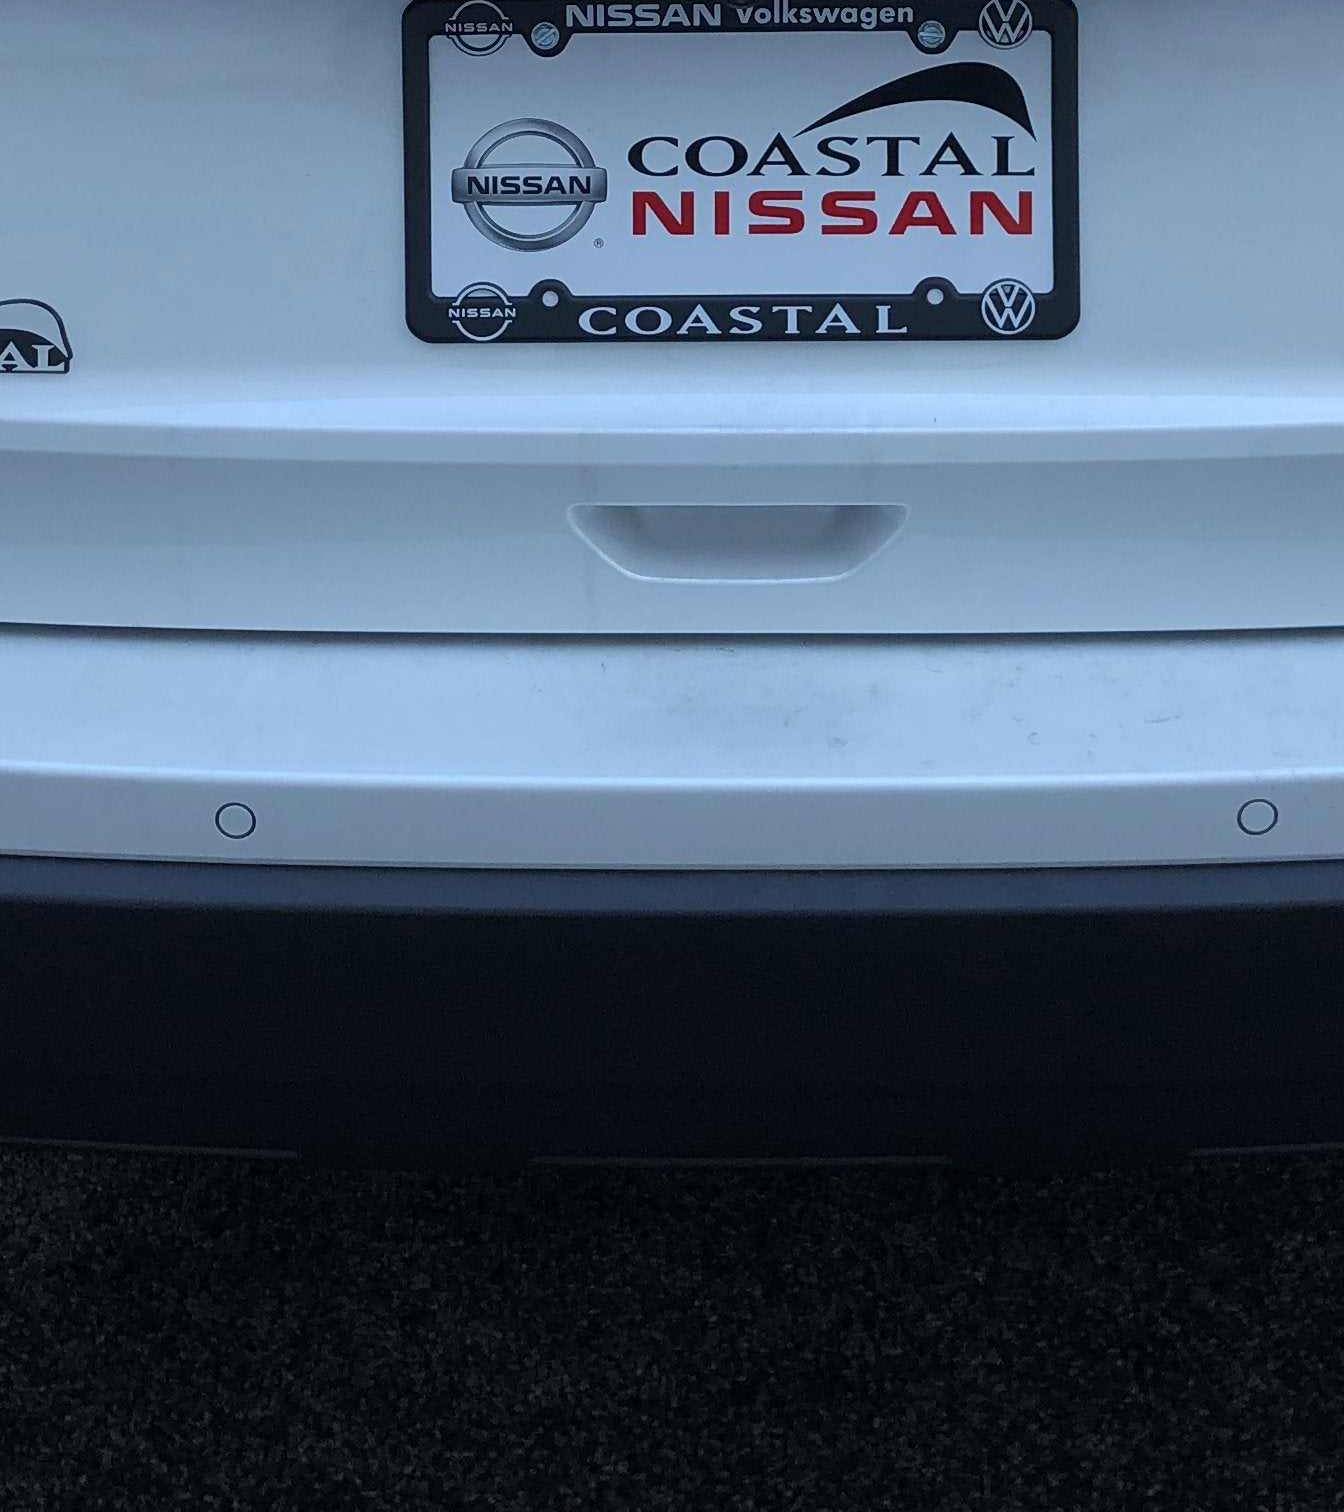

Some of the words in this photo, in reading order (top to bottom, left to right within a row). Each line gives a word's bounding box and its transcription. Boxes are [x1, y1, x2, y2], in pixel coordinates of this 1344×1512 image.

[565, 3, 722, 27] NISSAN
[445, 22, 513, 33] NISSAN
[627, 131, 1036, 177] COASTAL
[467, 175, 591, 195] NISSAN
[632, 190, 1033, 235] NISSAN
[448, 308, 516, 318] NISSAN
[577, 302, 908, 335] COASTAL
